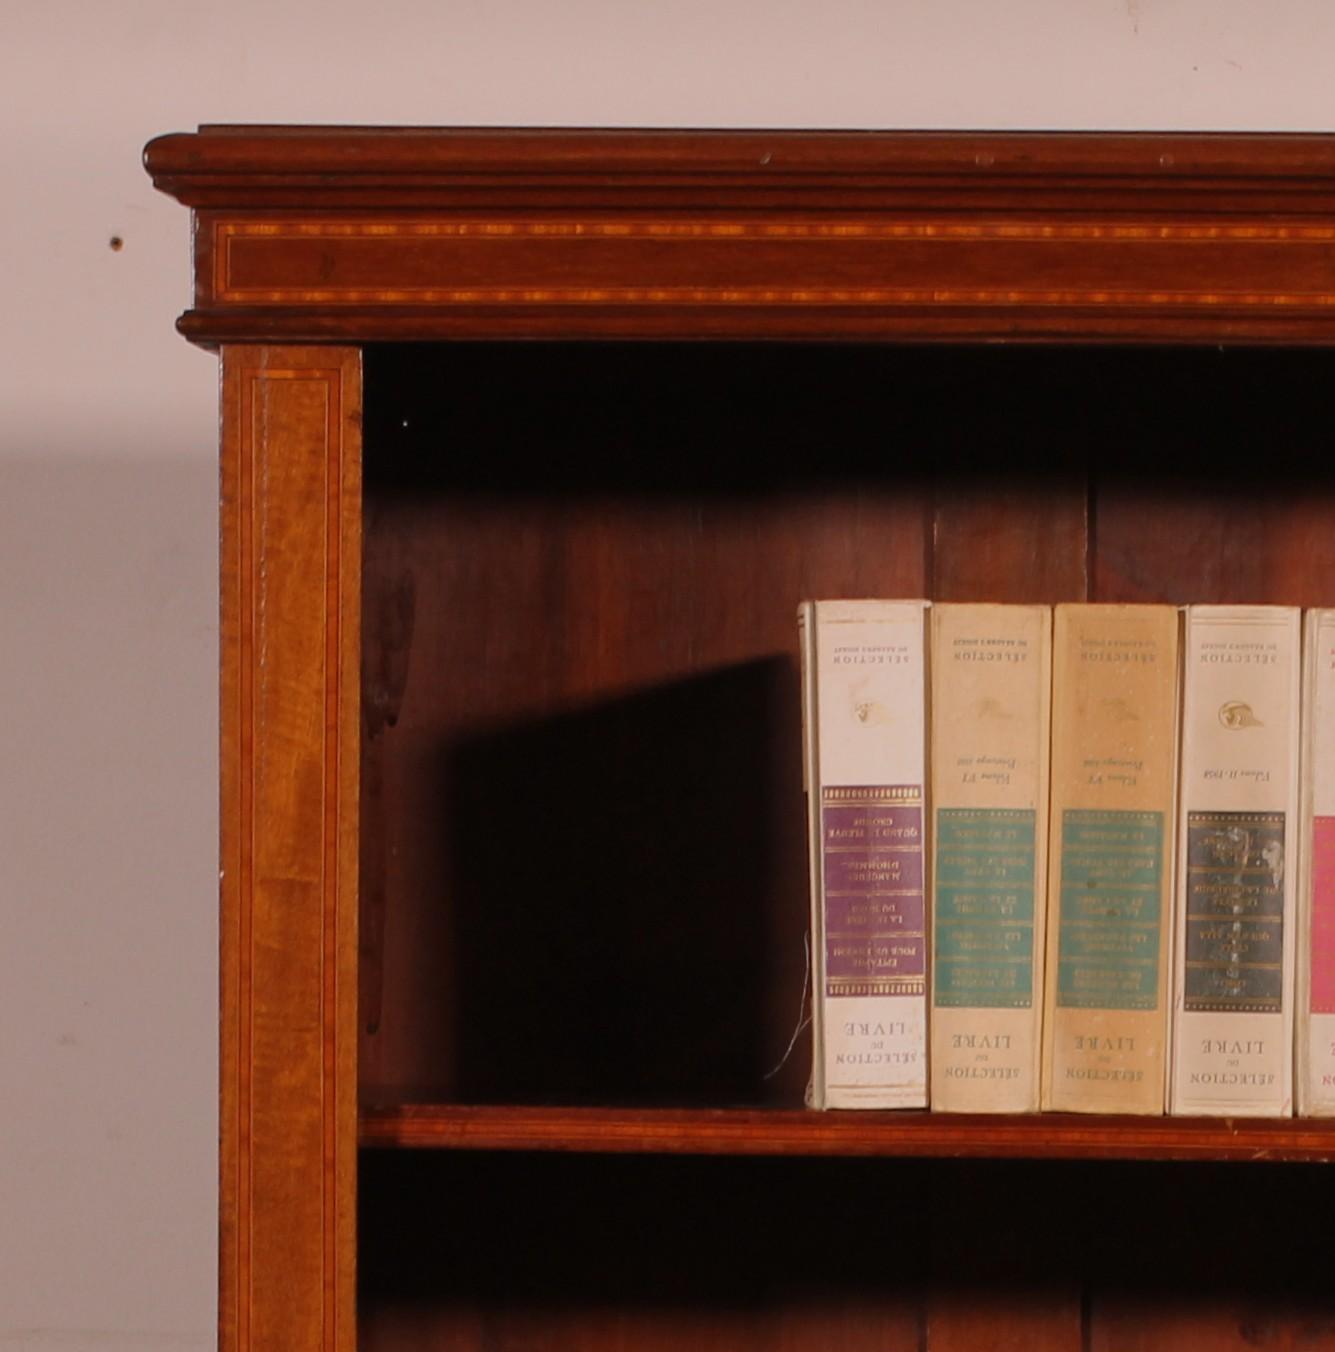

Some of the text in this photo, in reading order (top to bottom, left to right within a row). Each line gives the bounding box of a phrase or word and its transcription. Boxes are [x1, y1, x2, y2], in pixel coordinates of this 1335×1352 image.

[845, 1022, 904, 1036] LIVRE
[952, 1035, 1011, 1049] LIVRE
[1075, 1036, 1135, 1050] LIVRE
[1201, 1039, 1264, 1053] LIVRE
[836, 1053, 917, 1066] SÉLECTION
[945, 1067, 1020, 1081] SÉLECTION
[1066, 1068, 1143, 1082] SÉLECTION
[1190, 1073, 1274, 1086] SÉLECTION
